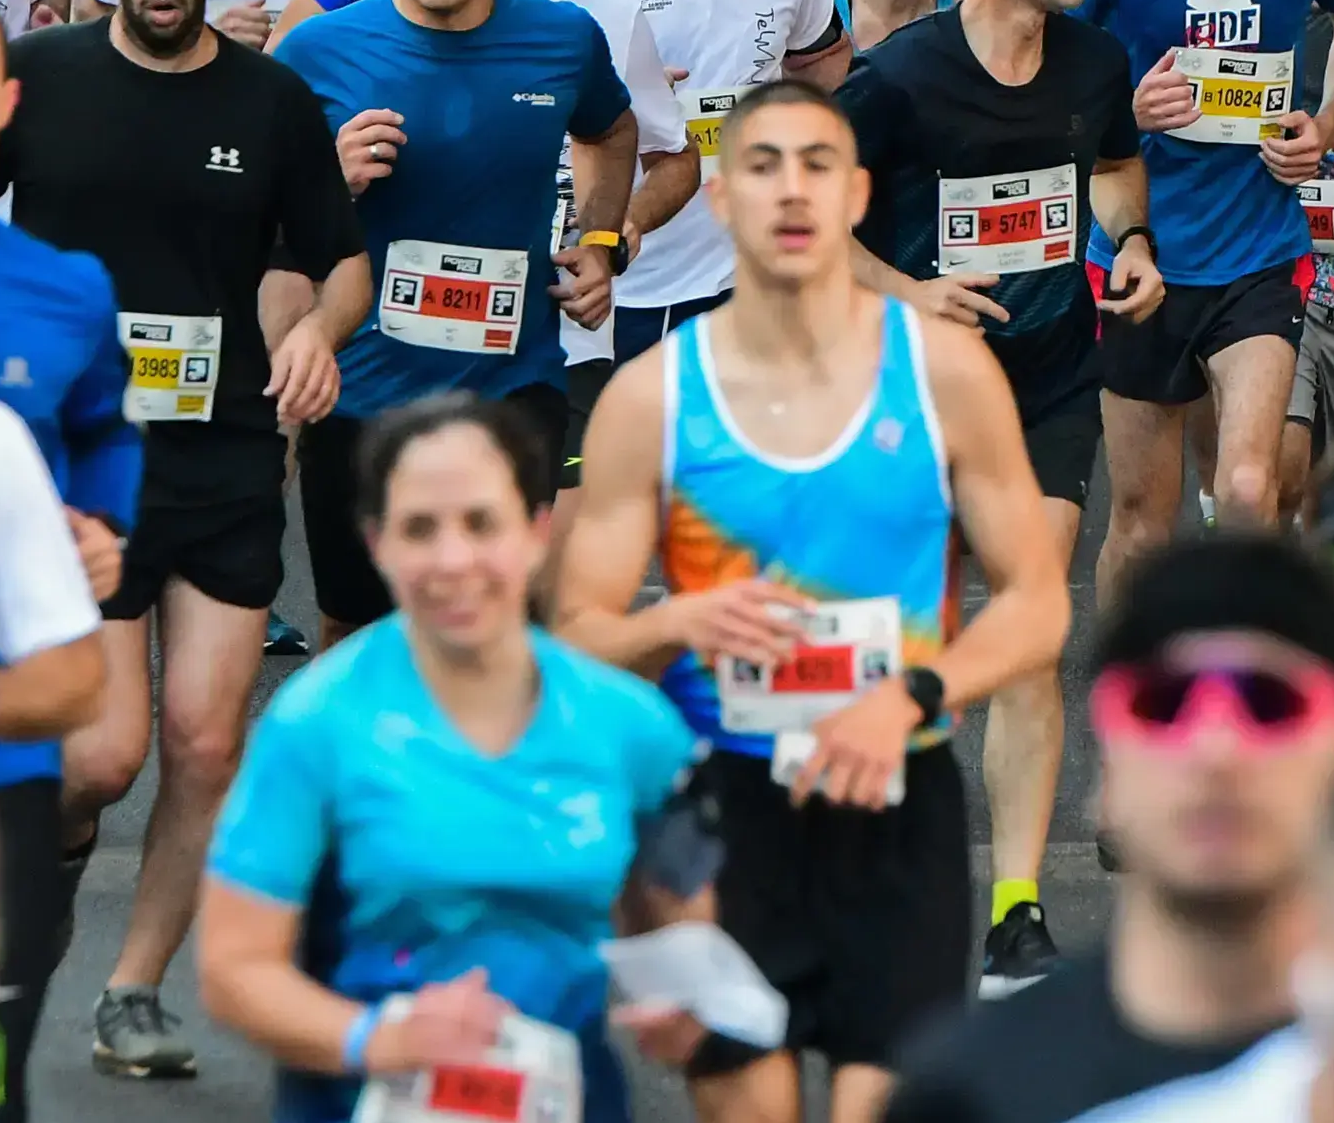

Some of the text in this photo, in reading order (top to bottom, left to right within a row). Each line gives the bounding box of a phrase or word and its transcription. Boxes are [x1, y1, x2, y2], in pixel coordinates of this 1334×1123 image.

[1189, 7, 1258, 45] FIDF
[1217, 89, 1262, 108] 10824
[999, 211, 1037, 234] 5747
[442, 288, 481, 310] 8211
